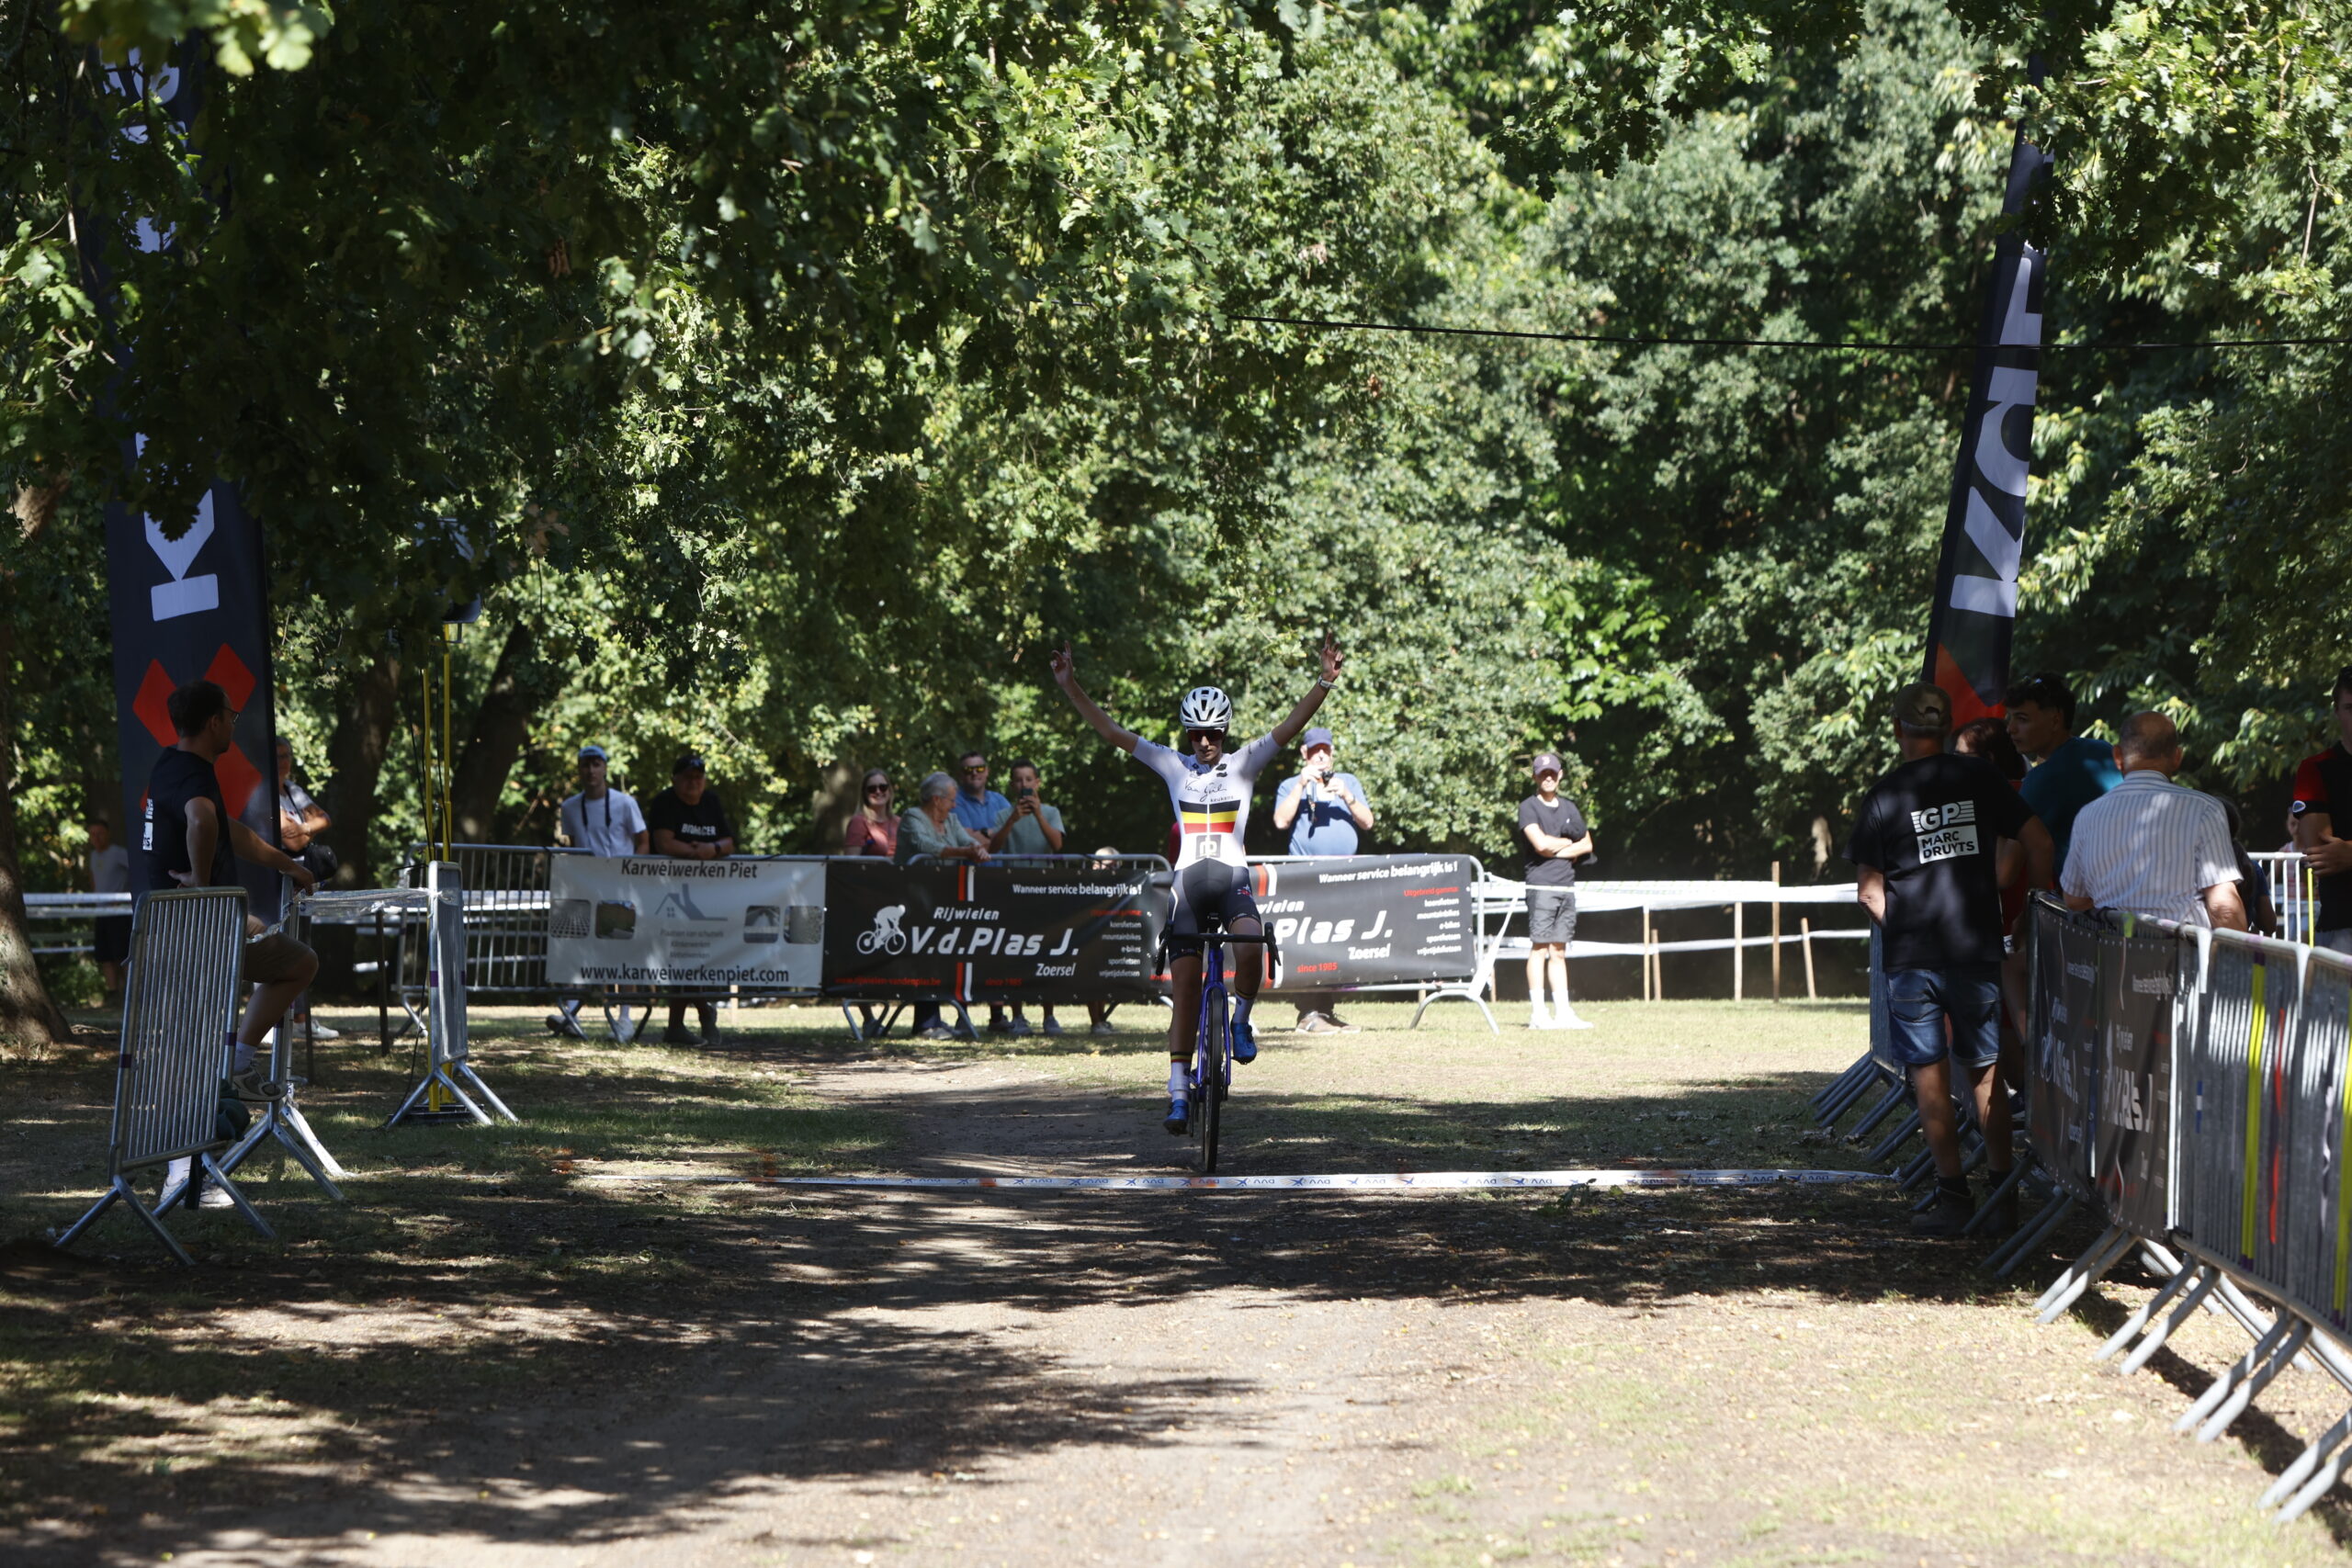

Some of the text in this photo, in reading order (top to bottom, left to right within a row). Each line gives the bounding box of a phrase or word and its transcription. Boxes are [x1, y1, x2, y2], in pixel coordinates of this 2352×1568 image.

[1920, 802, 1961, 831] GP
[1921, 831, 1960, 849] MARC
[1923, 841, 1975, 859] DRUYTS
[621, 859, 757, 878] Karweiwerken Piet
[1319, 873, 1356, 884] Wanneer
[1357, 869, 1389, 881] service
[1390, 861, 1444, 878] belangrijk
[1012, 883, 1142, 898] Wanneer service belangrijk is!
[934, 907, 1000, 922] Rijwielen
[1360, 910, 1393, 939] J.
[1439, 921, 1460, 930] e-bikes
[911, 926, 1080, 956] V.d.Plas J.
[1101, 933, 1142, 941] mountainbikes
[1348, 943, 1391, 961] Zoersel
[581, 963, 789, 985] www.karweiwerkenpiet.com
[1036, 962, 1076, 977] Zoersel
[1297, 962, 1338, 973] since 1985
[985, 979, 1004, 987] since
